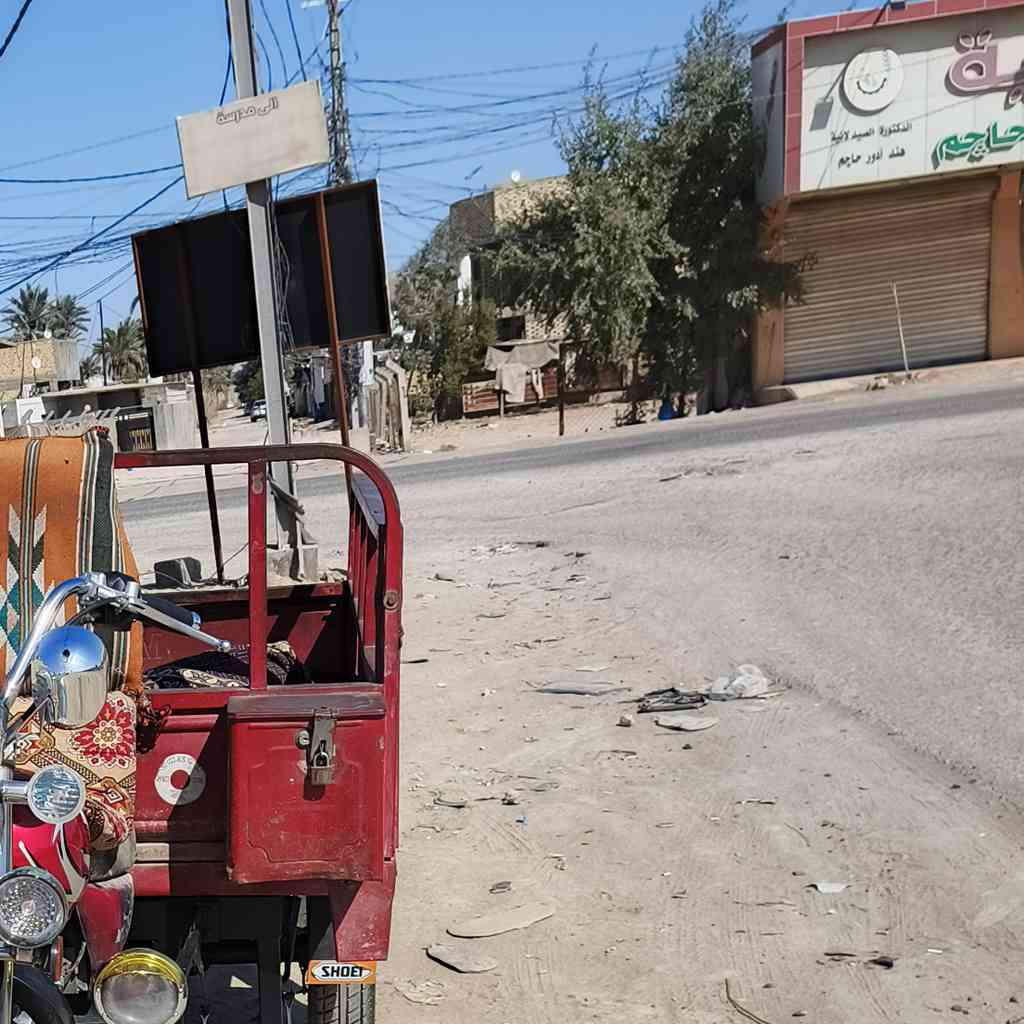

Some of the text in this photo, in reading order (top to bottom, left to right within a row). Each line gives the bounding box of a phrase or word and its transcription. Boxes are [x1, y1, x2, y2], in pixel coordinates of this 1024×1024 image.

[216, 105, 257, 125] مدرسة
[879, 121, 912, 139] الدكتورة
[321, 965, 364, 978] SHOEI
